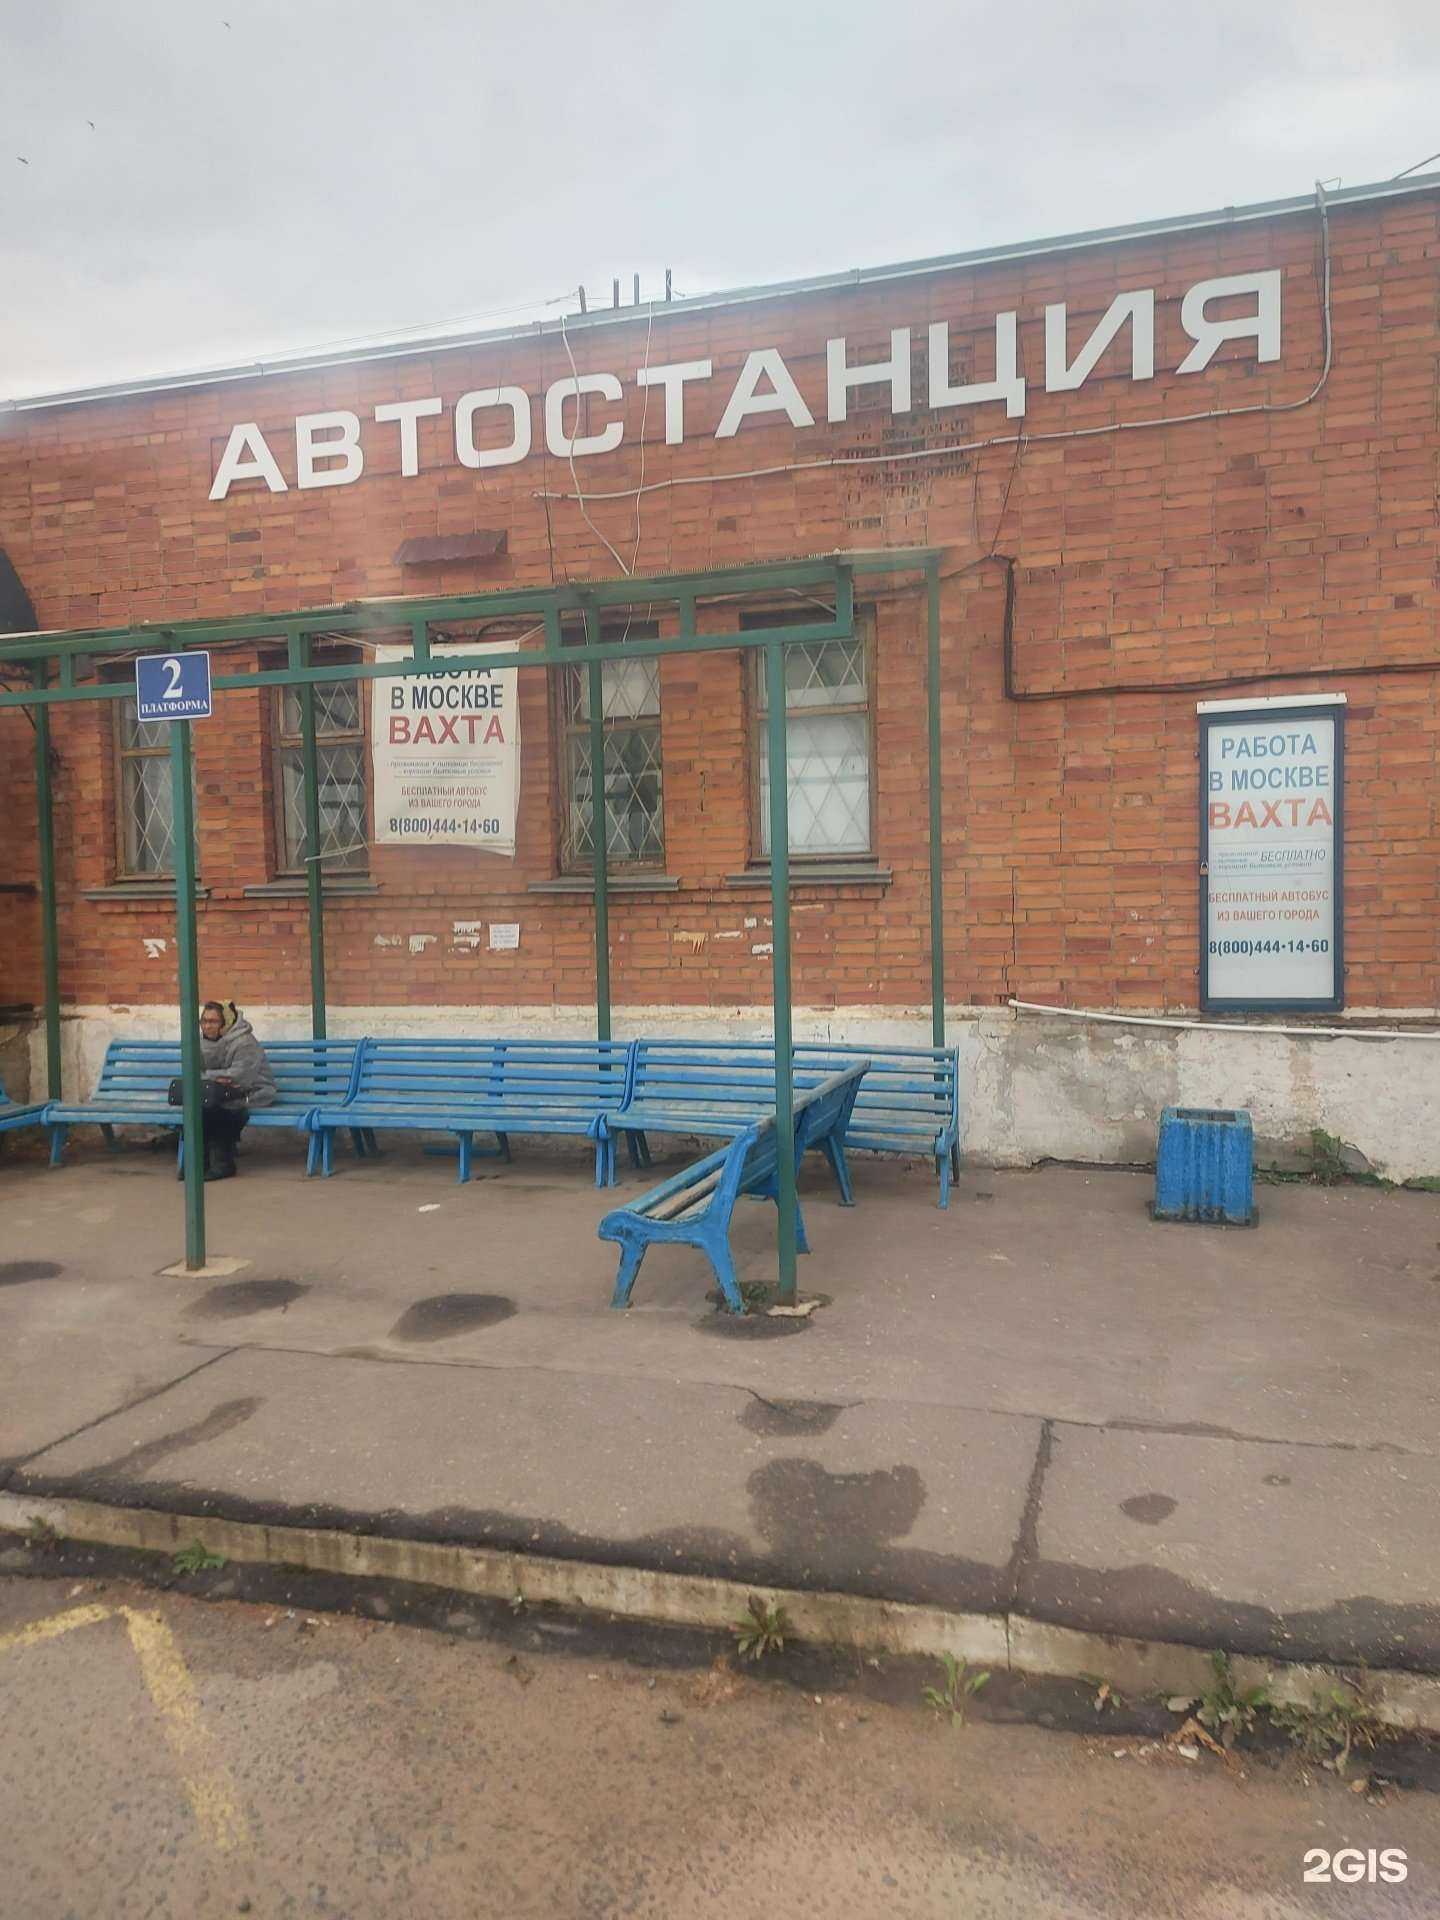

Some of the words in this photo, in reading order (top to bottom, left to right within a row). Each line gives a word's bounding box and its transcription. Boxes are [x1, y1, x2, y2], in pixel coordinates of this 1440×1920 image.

[209, 268, 1283, 501] АВТОСТАНЦИЯ
[161, 658, 184, 699] 2
[141, 699, 209, 714] ПЛАТФОРМА
[391, 686, 405, 710] В
[412, 684, 504, 710] МОСКВЕ
[388, 715, 505, 745] ВАХТА
[1221, 733, 1317, 760] РАБОТА
[401, 785, 455, 796] БЕСПЛАТНЫЙ
[456, 785, 487, 796] АВТОБУС
[1209, 771, 1224, 792] В
[1231, 765, 1329, 791] МОСКВЕ
[408, 798, 419, 809] ИЗ
[421, 798, 453, 809] ВАШЕГО
[454, 798, 481, 809] ГОРОДА
[1208, 797, 1333, 830] ВАХТА
[1260, 848, 1327, 863] БЕСПЛАТНО
[1208, 890, 1279, 903] БЕСПЛАТНЫЙ
[1281, 890, 1329, 902] АВТОБУС
[1217, 911, 1230, 921] ИЗ
[1233, 910, 1276, 921] ВАШЕГО
[1278, 909, 1320, 921] ГОРОДА
